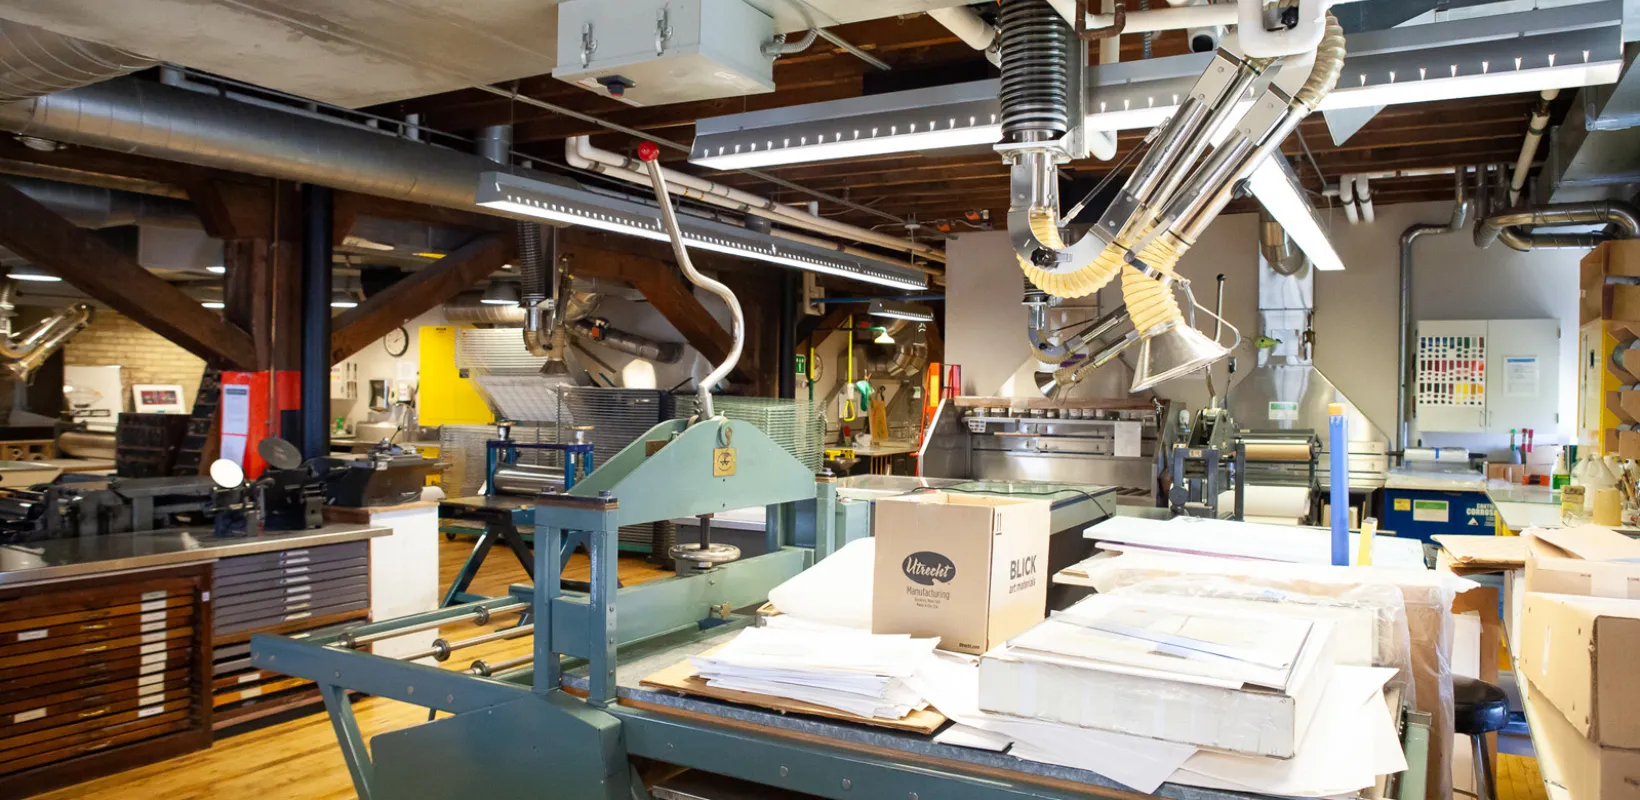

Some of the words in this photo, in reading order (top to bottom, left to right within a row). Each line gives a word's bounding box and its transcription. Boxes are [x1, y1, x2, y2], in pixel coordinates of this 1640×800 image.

[906, 556, 953, 578] Utrecht
[1009, 554, 1036, 580] BLICK
[906, 586, 950, 601] Manufacturing
[1008, 583, 1016, 595] art
